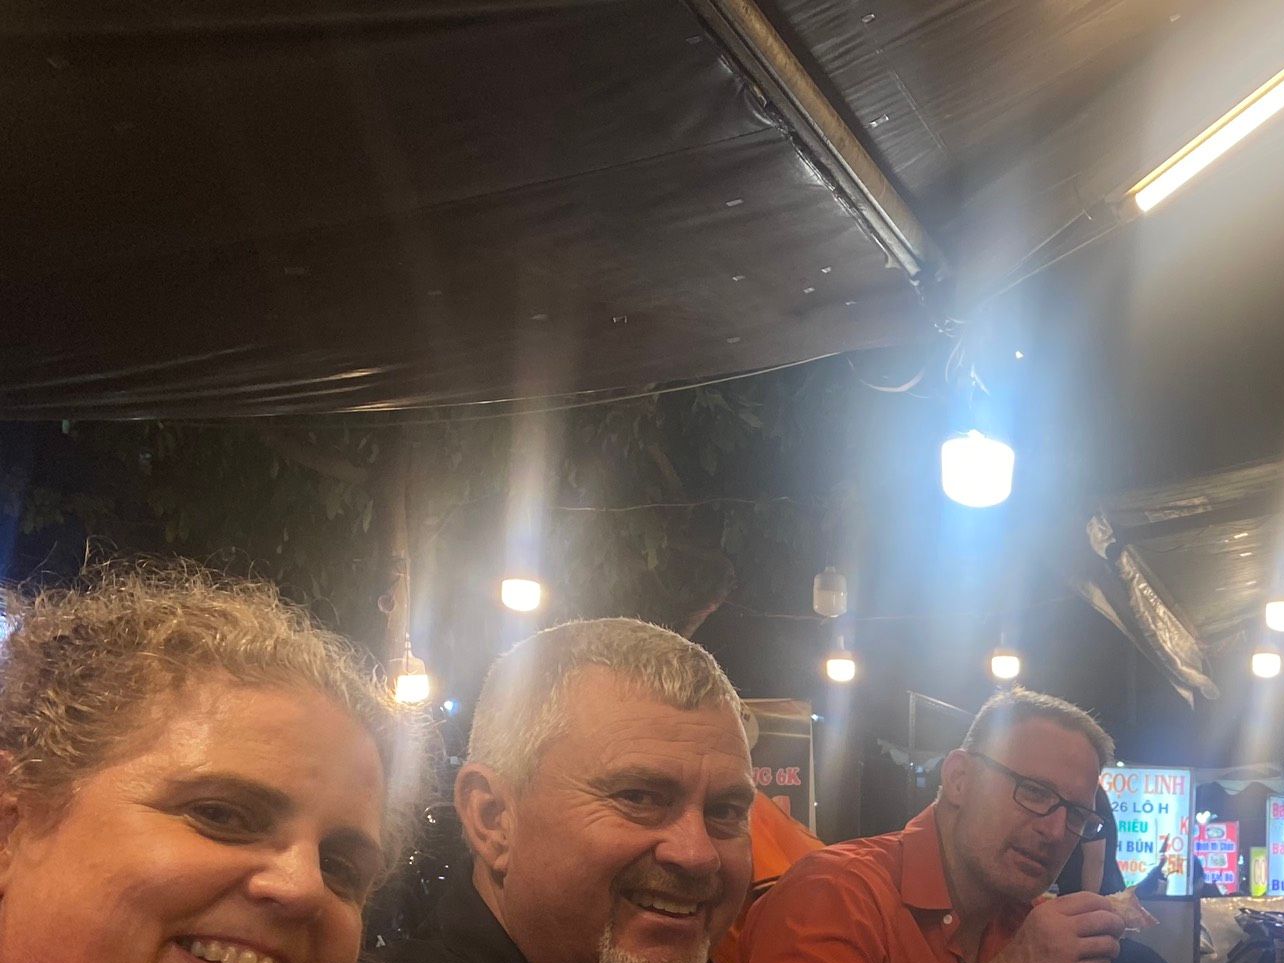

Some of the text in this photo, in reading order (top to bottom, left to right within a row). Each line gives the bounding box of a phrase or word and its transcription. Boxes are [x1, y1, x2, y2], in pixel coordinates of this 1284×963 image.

[775, 766, 801, 786] 6K
[1100, 772, 1186, 799] GỌC LINH
[1133, 799, 1154, 815] LÔ
[1158, 802, 1170, 814] H
[1126, 838, 1154, 853] BÚN
